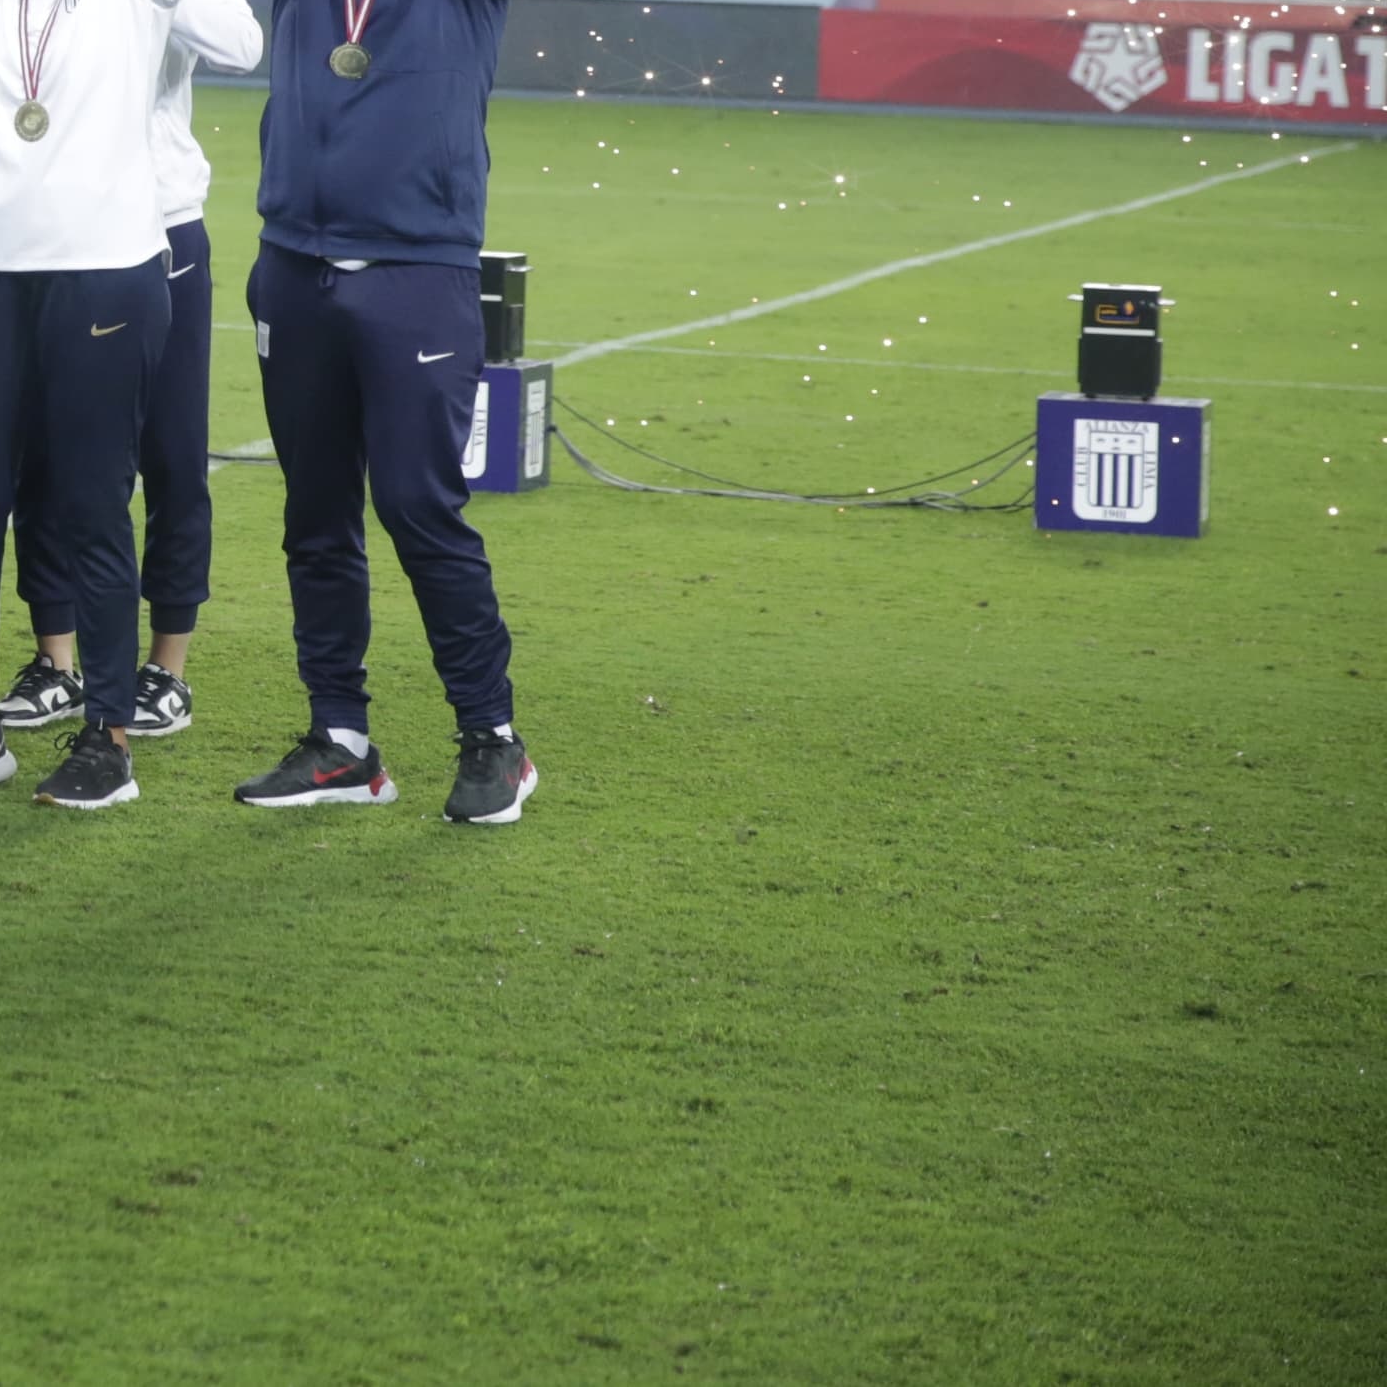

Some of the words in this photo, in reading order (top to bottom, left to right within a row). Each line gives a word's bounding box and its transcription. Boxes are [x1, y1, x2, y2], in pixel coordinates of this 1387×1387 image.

[1187, 28, 1350, 108] LIGA
[1084, 421, 1149, 433] ALIANZA
[1144, 451, 1156, 489] LIMA
